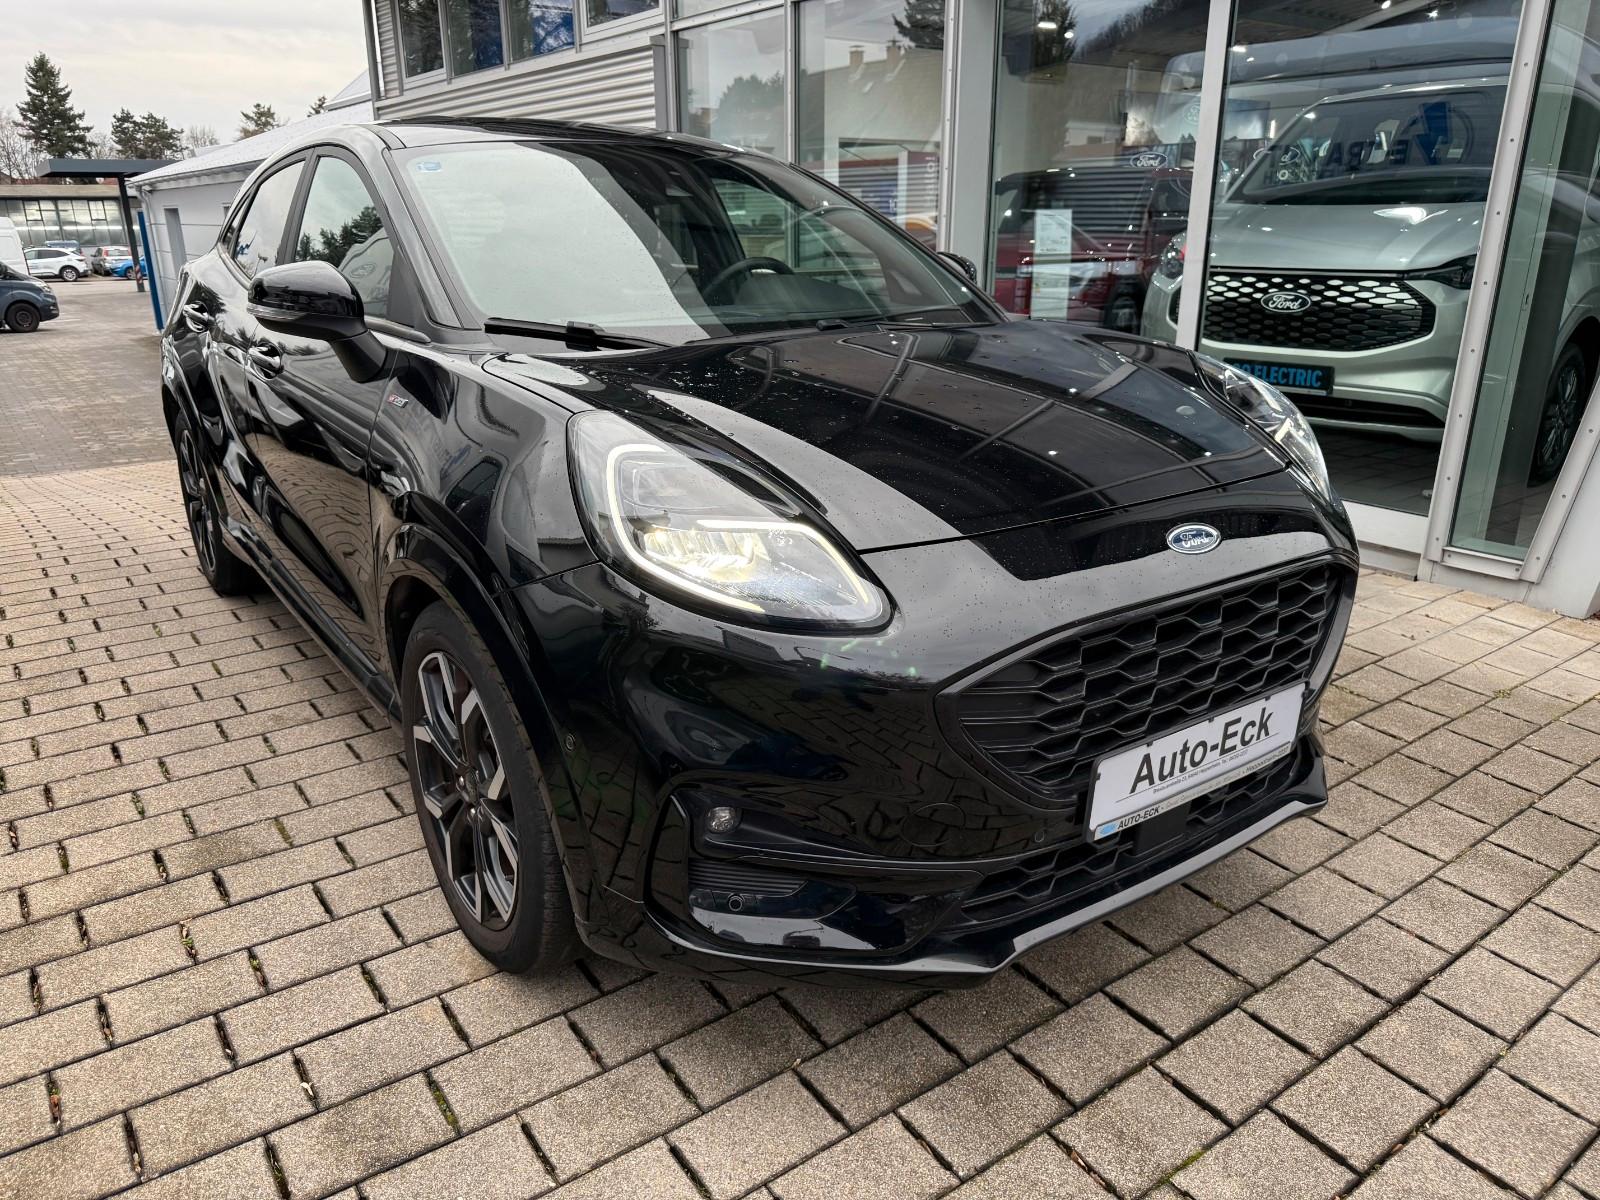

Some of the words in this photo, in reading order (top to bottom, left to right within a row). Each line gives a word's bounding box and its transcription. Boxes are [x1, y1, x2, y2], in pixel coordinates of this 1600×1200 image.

[1269, 294, 1302, 309] Ford
[1179, 530, 1212, 548] Ford
[1129, 707, 1274, 794] Auto-Eck
[1117, 806, 1161, 830] AUTO-ECK
